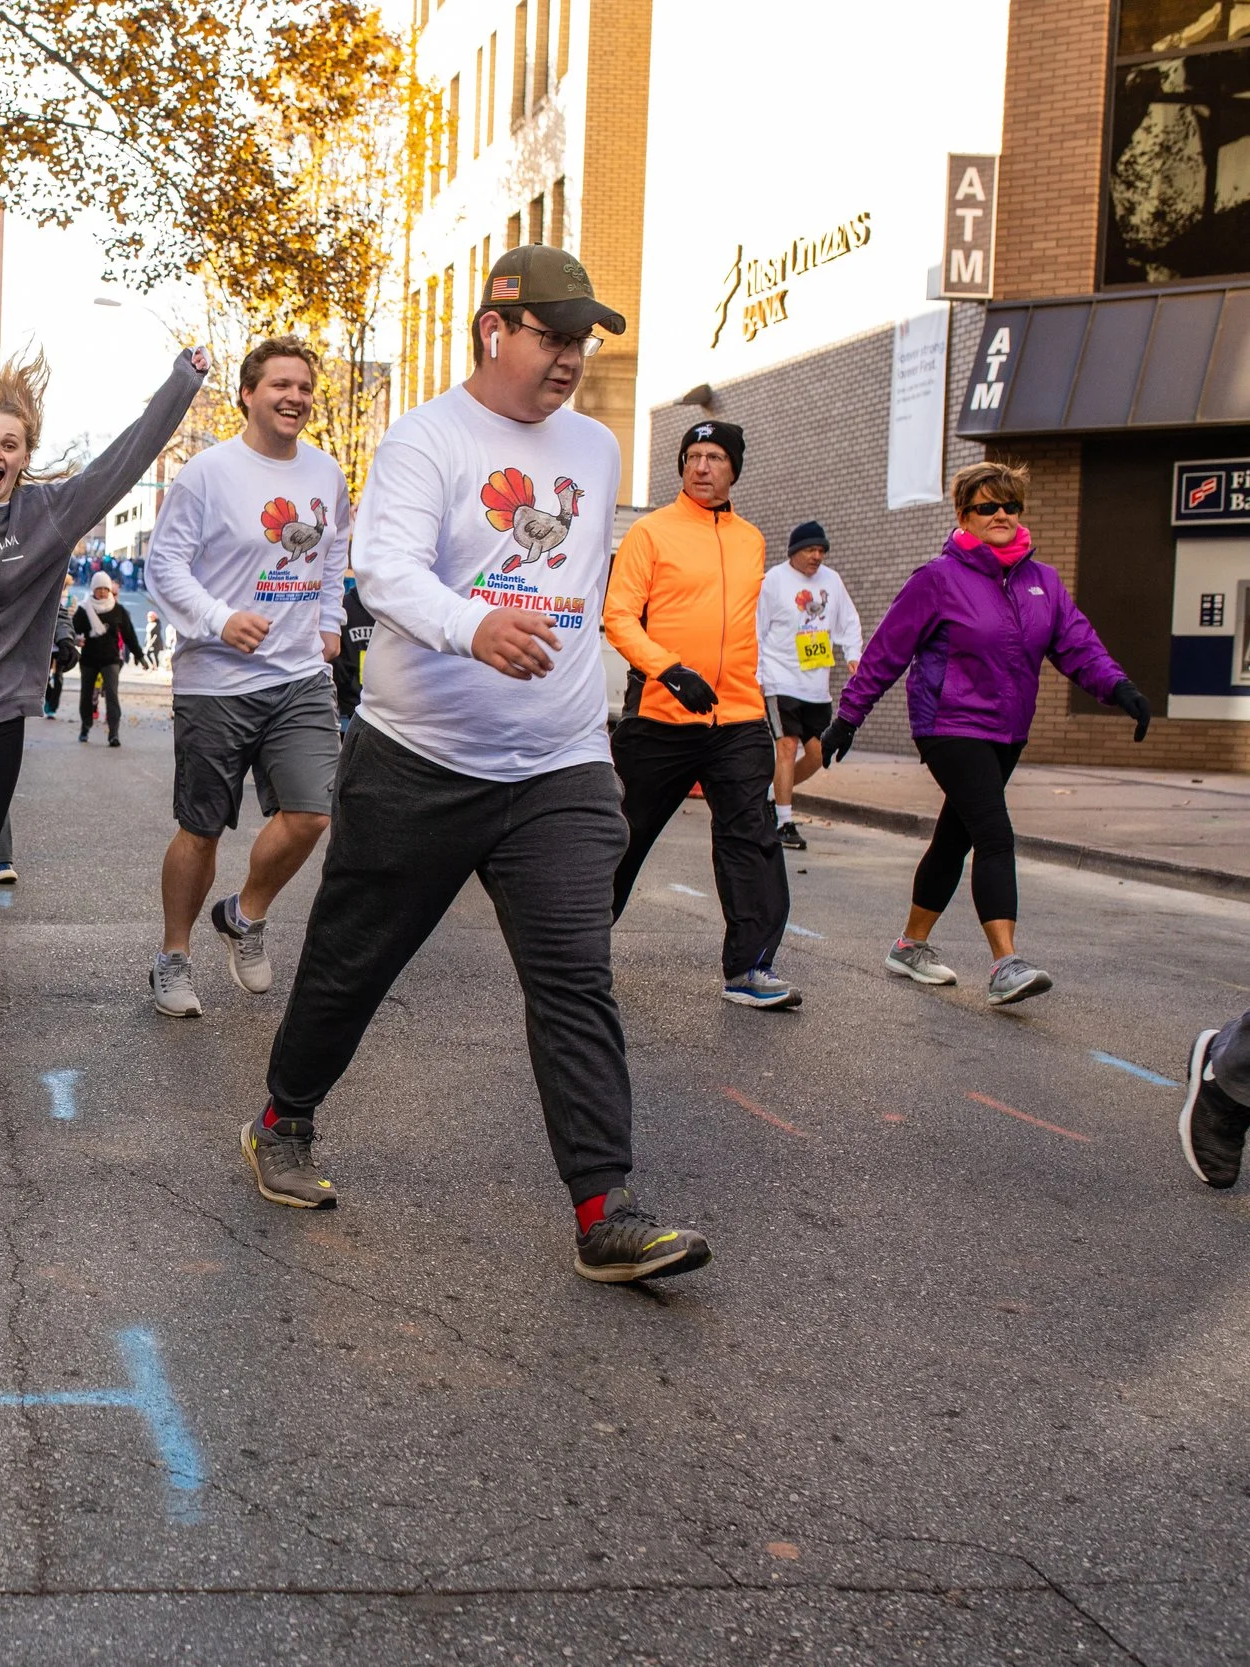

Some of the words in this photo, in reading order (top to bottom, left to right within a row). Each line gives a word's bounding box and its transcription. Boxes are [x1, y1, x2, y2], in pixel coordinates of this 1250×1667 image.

[949, 166, 986, 284] ATM
[969, 327, 1011, 411] ATM
[488, 572, 526, 584] Atlantic
[487, 580, 515, 591] Union
[517, 583, 539, 593] Bank
[303, 591, 319, 601] 201
[470, 588, 552, 611] DRUMSTICK
[553, 596, 585, 614] DASH
[549, 613, 583, 629] 2019
[804, 642, 827, 657] 525
